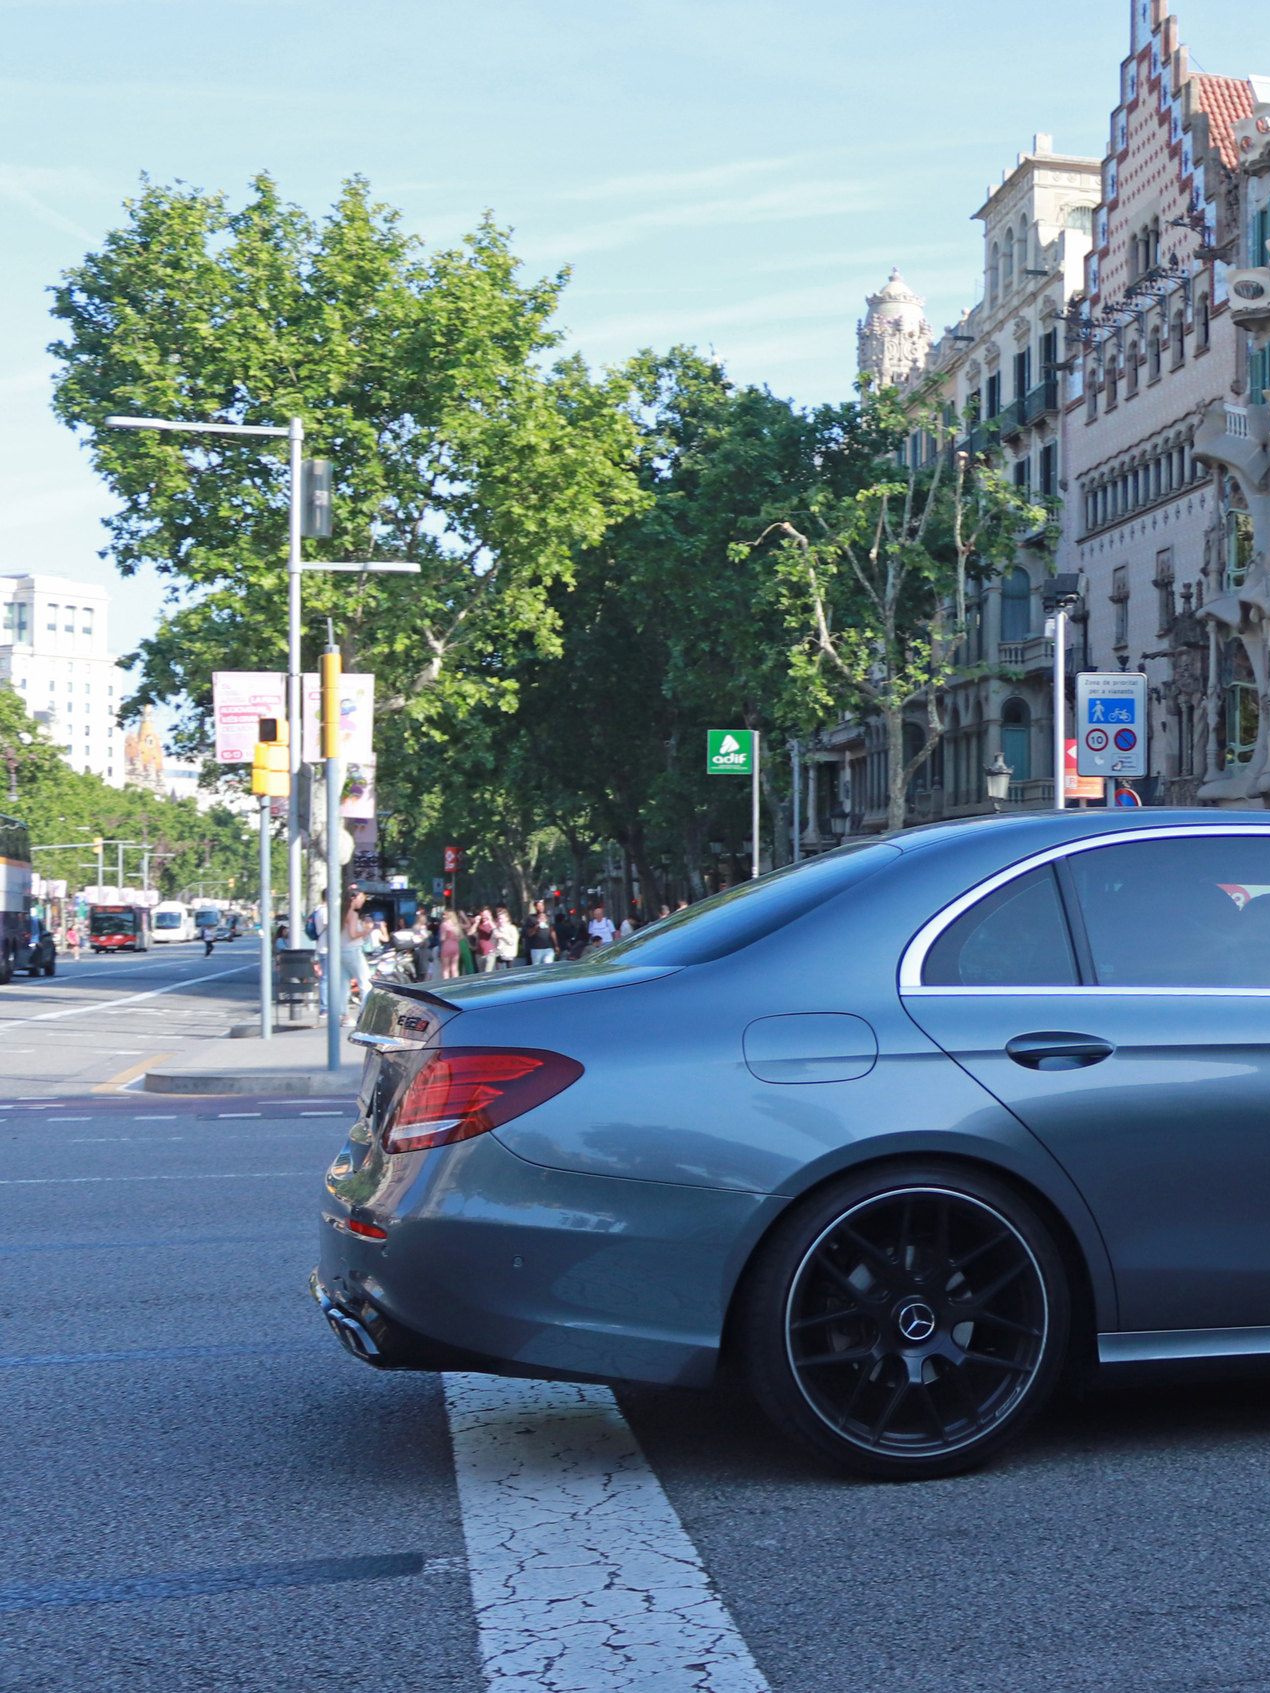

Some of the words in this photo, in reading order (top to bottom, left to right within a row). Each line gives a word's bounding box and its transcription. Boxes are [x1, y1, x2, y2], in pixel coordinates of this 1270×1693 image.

[1113, 679, 1138, 687] prioritat
[1091, 736, 1103, 744] 10
[712, 753, 747, 764] adif
